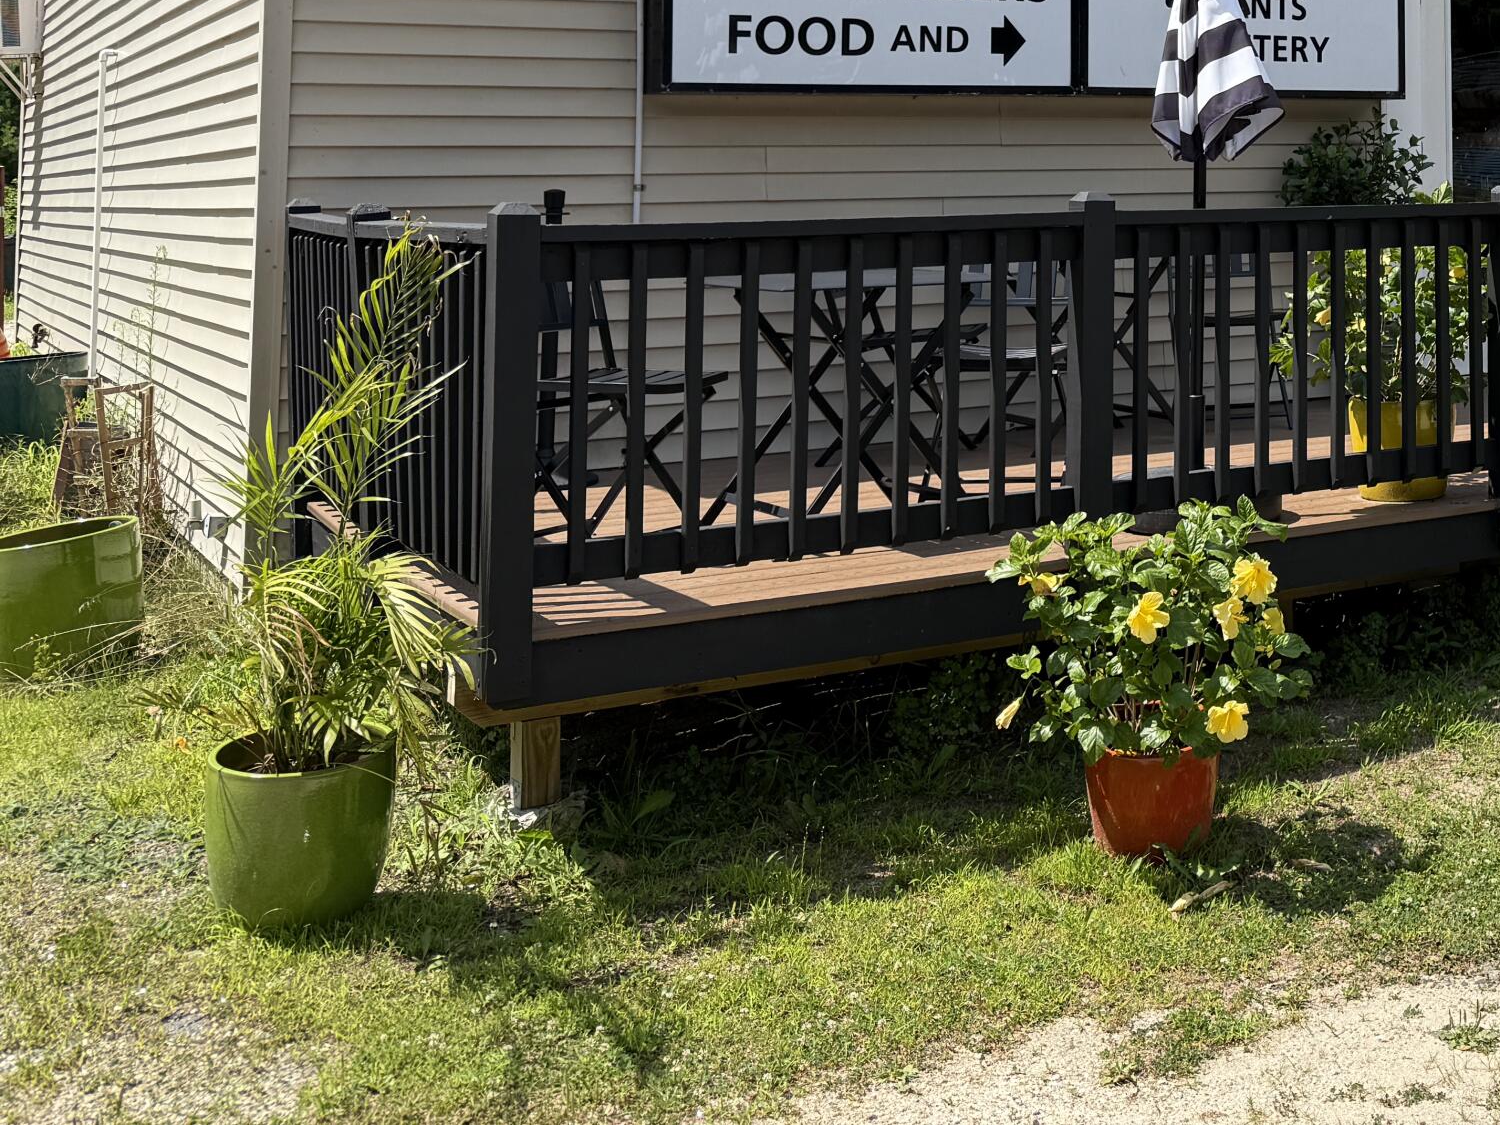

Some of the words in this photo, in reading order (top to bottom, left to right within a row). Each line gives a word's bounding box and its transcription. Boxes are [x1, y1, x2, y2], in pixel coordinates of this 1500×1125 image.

[727, 13, 876, 57] FOOD
[889, 24, 970, 54] AND
[1252, 34, 1330, 63] TERY
